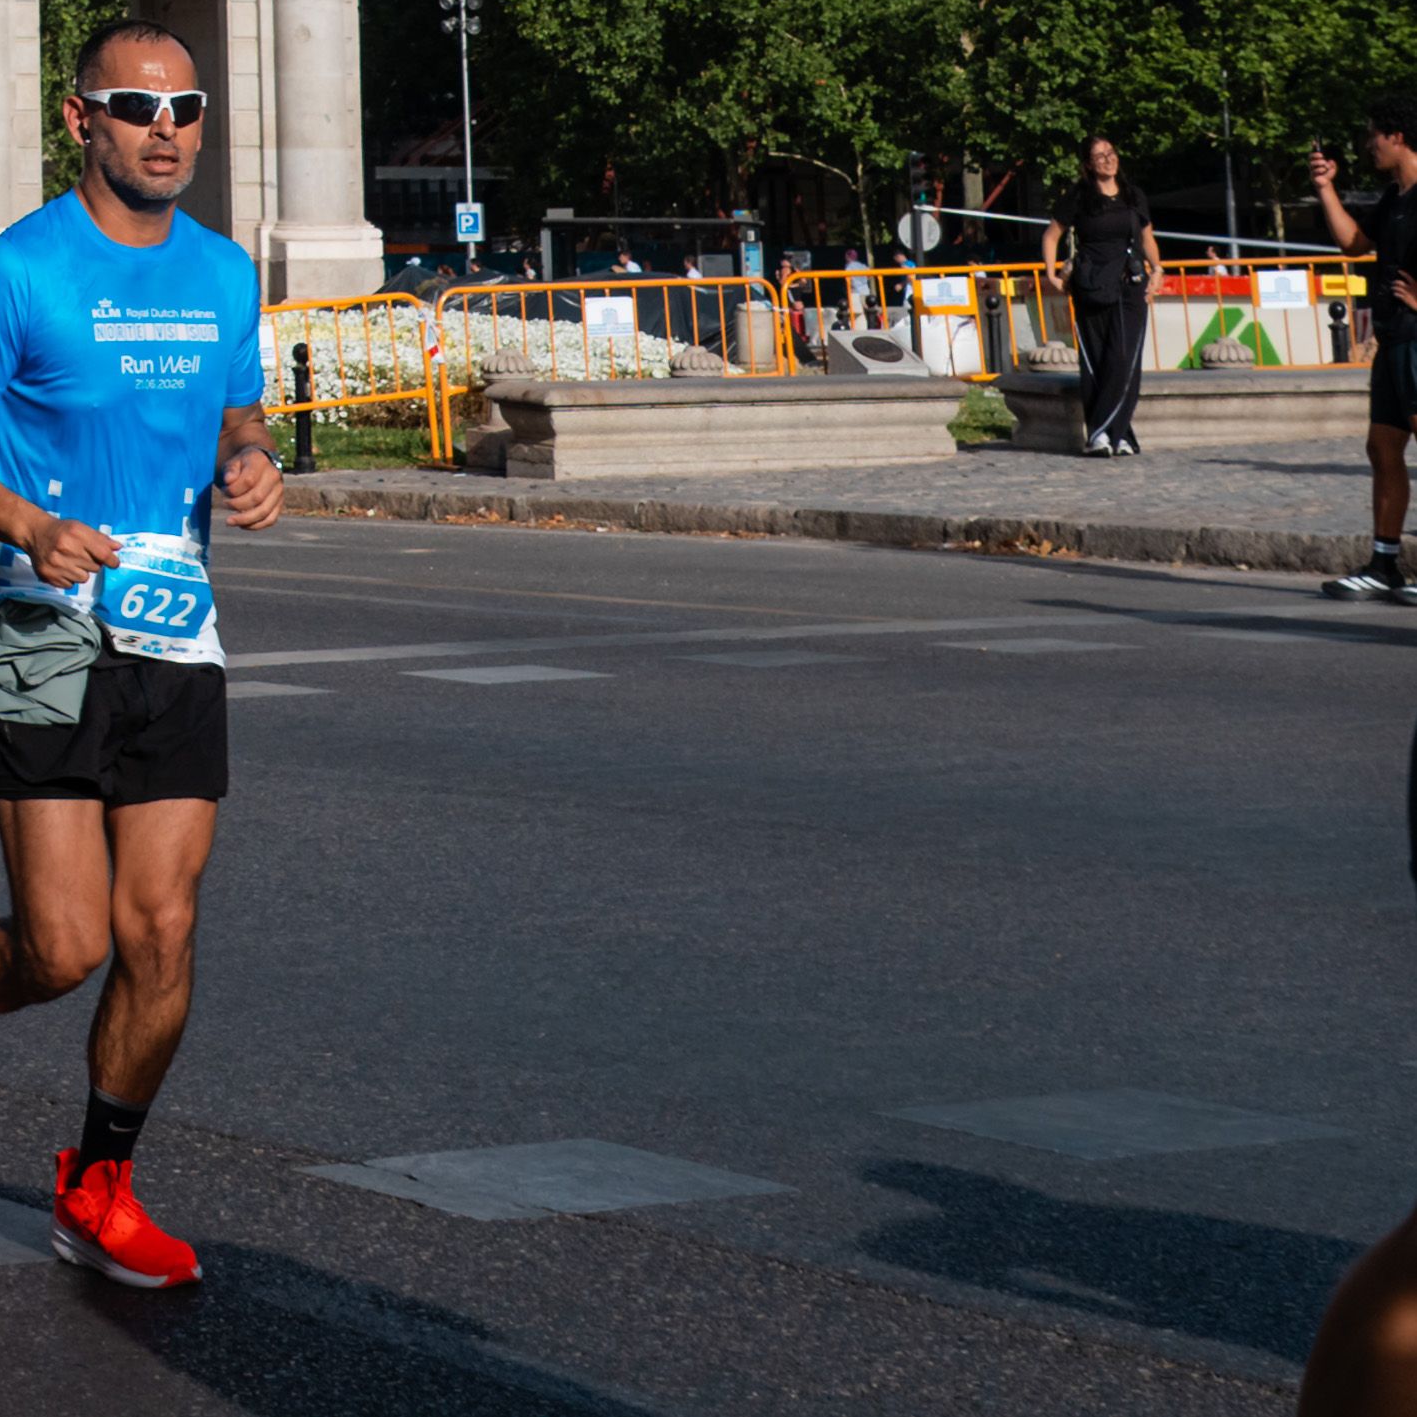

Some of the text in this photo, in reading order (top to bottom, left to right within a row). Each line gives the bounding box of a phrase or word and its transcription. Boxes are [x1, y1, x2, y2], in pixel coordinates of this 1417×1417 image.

[91, 308, 216, 320] KLM Royal Dutch Airlines
[94, 324, 219, 341] NORTE VS SUR
[120, 355, 201, 374] Run Well
[120, 583, 197, 627] 622
